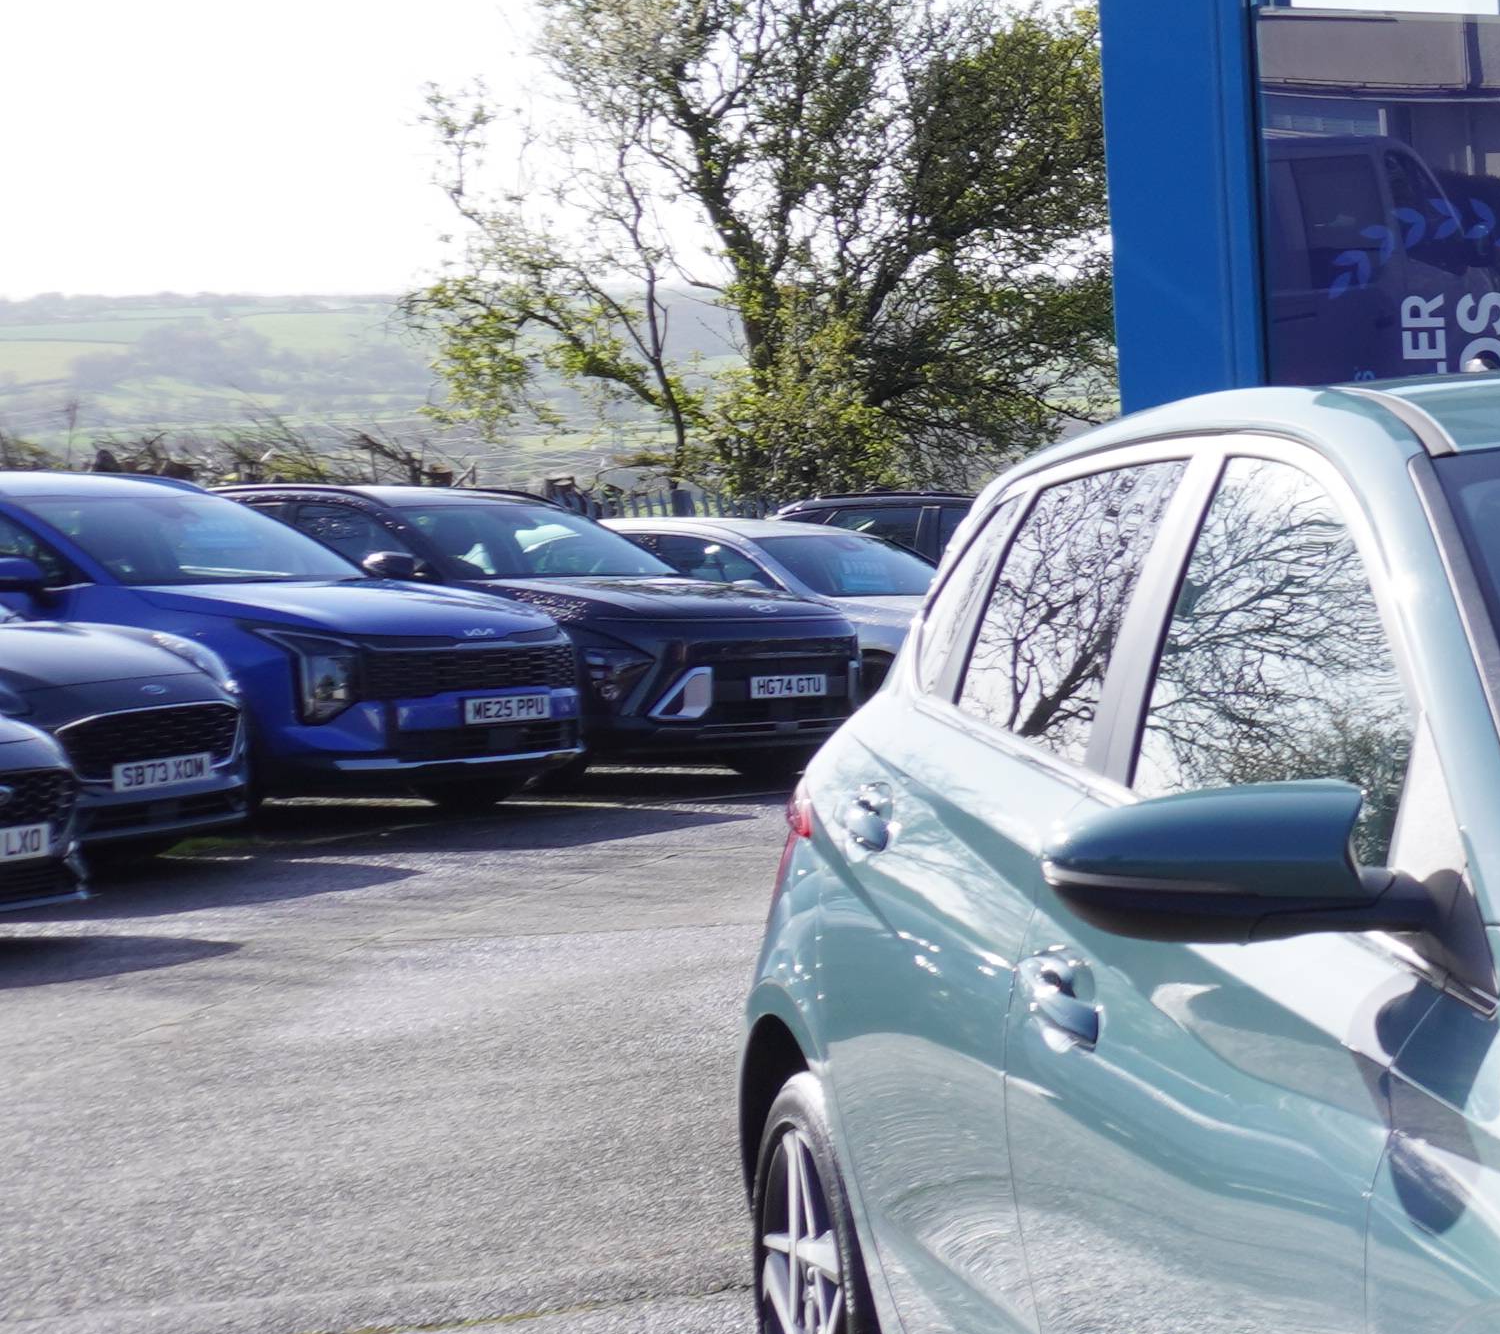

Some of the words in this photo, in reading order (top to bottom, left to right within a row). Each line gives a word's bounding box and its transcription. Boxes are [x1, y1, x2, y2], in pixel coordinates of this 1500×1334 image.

[1401, 293, 1448, 374] ER
[757, 678, 794, 695] HG74
[795, 677, 821, 693] GTU
[472, 700, 513, 720] ME25
[516, 697, 545, 717] PPU
[121, 765, 169, 787] SB73
